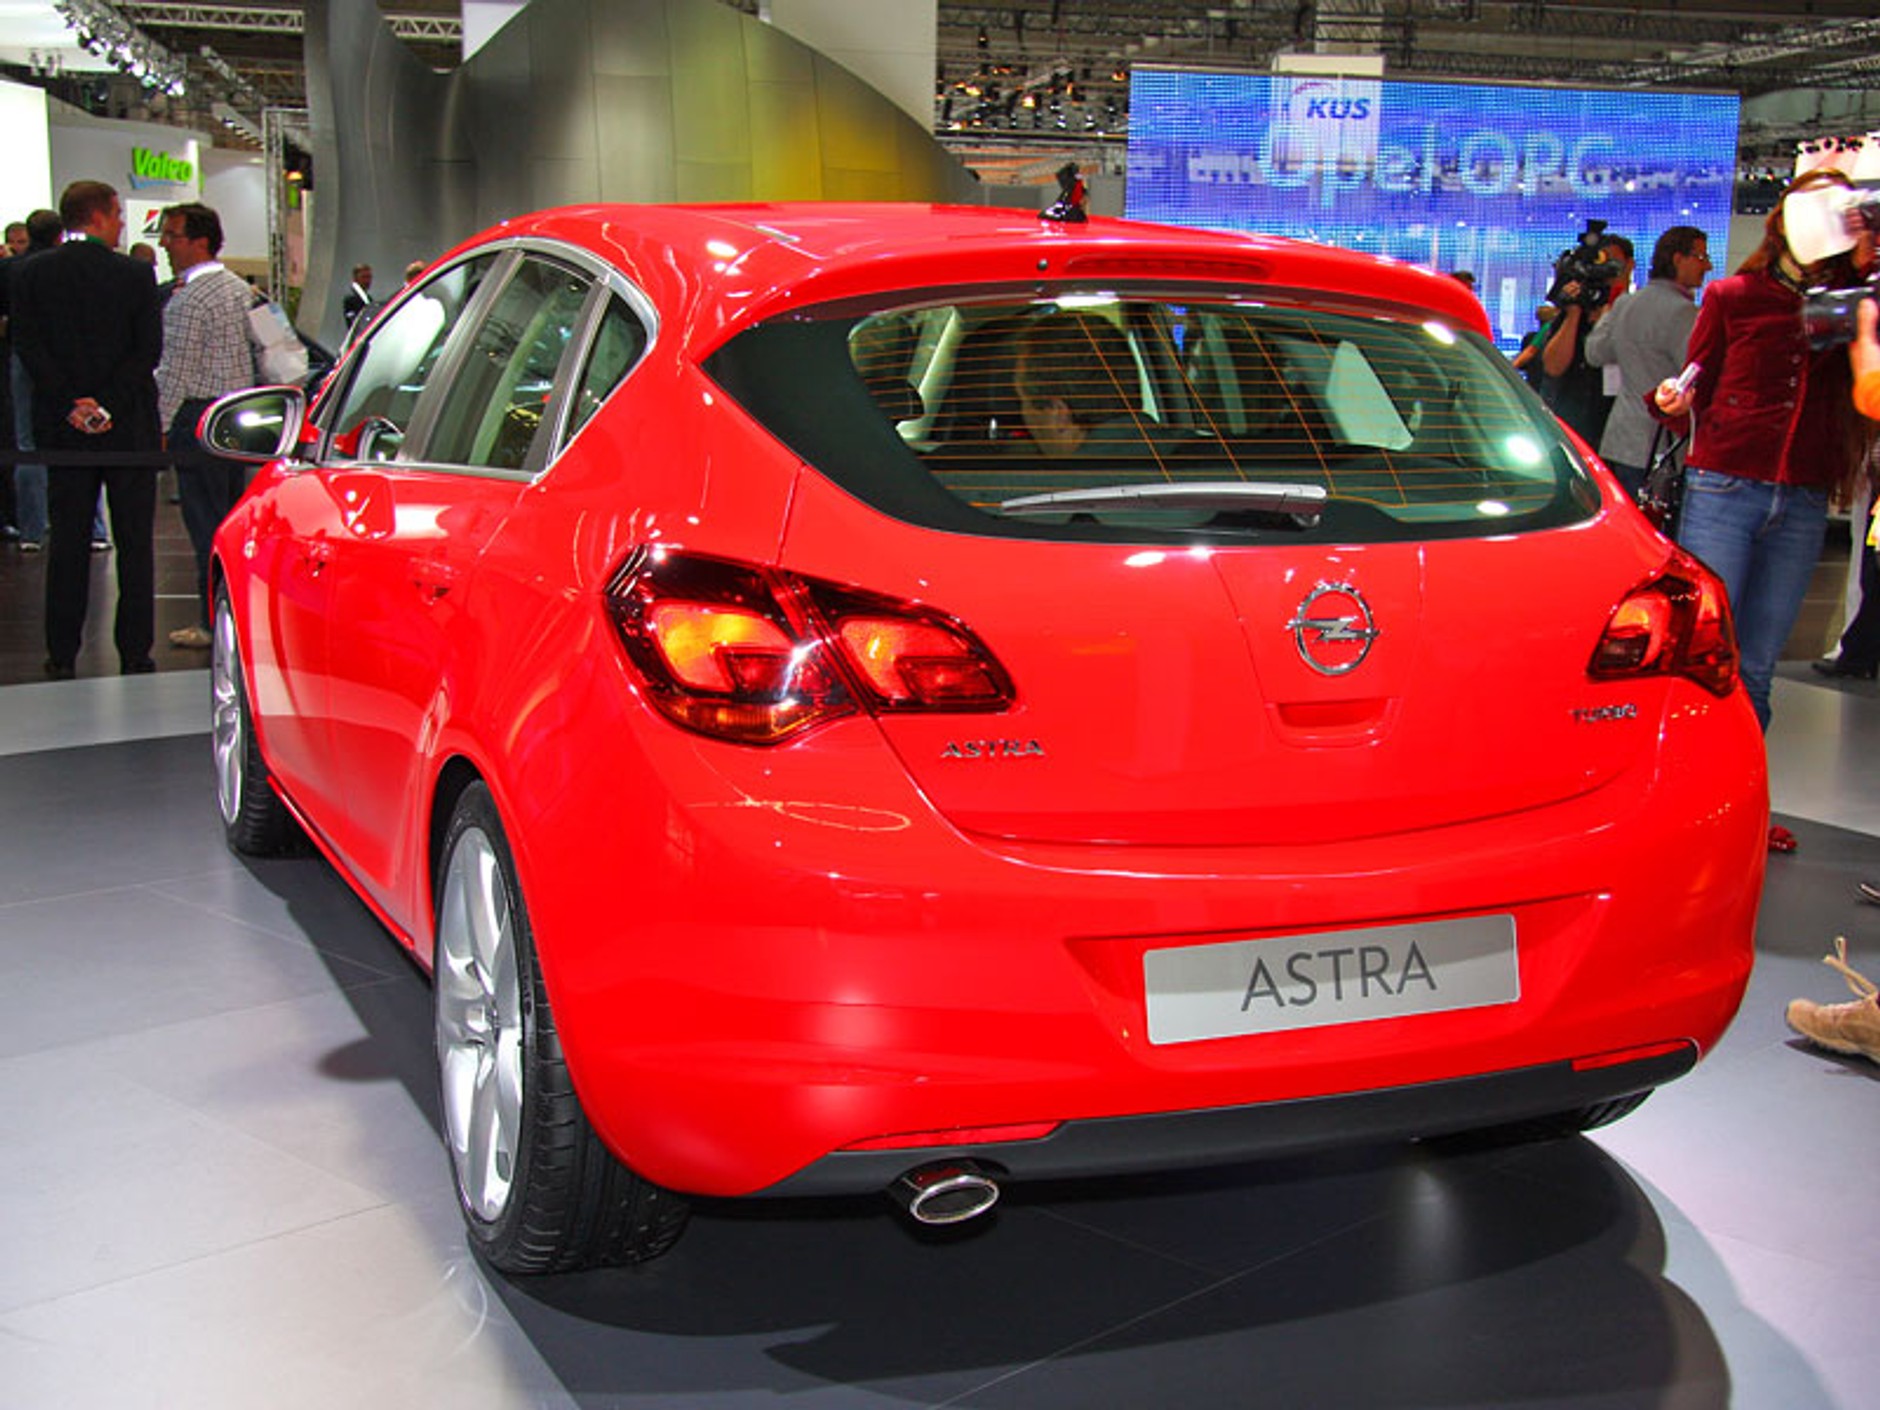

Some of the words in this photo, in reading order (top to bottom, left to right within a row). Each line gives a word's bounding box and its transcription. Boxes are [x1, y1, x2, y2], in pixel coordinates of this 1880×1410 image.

[132, 147, 193, 182] Valeo
[1460, 127, 1614, 199] OPC
[940, 739, 1044, 758] ASTRA
[1241, 940, 1437, 1012] ASTRA
